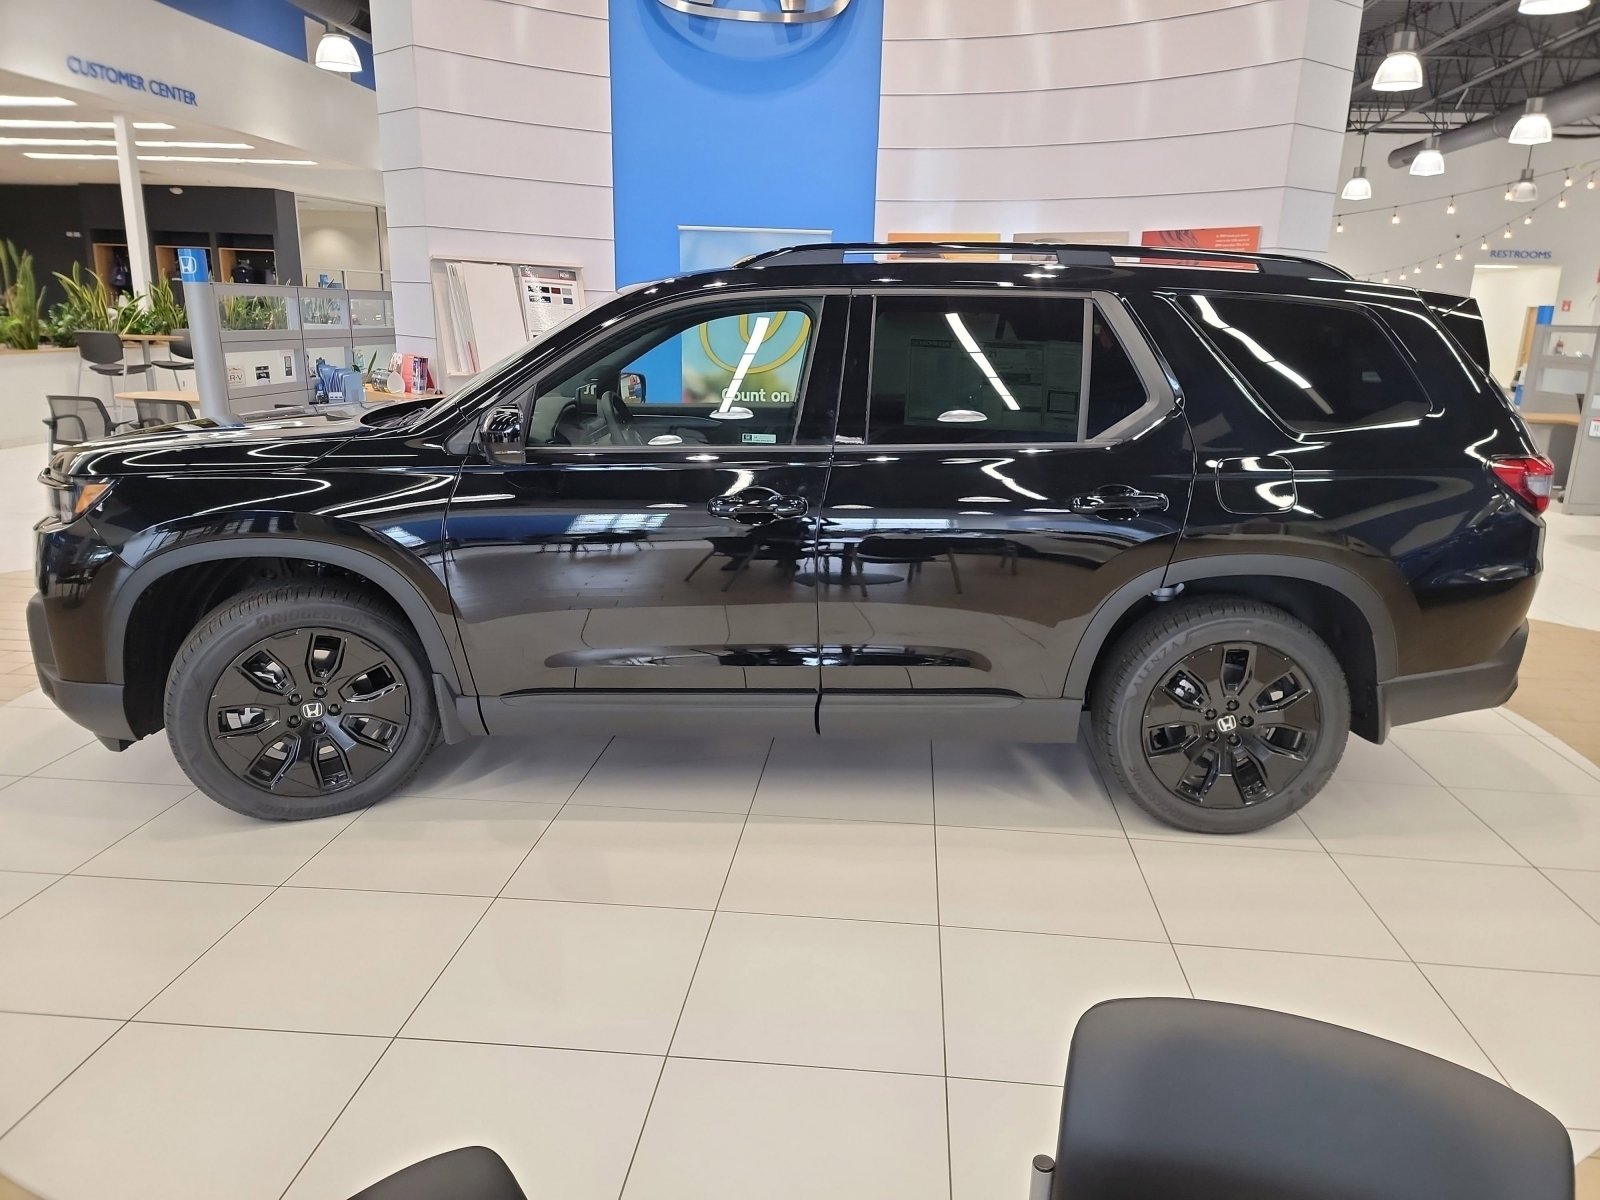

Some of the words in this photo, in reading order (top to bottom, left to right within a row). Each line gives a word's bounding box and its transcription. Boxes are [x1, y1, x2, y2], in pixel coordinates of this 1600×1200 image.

[66, 55, 146, 92] CUSTOMER
[149, 80, 198, 106] CENTER
[1490, 249, 1552, 259] RESTROOMS
[721, 387, 766, 402] Count
[771, 391, 790, 402] on
